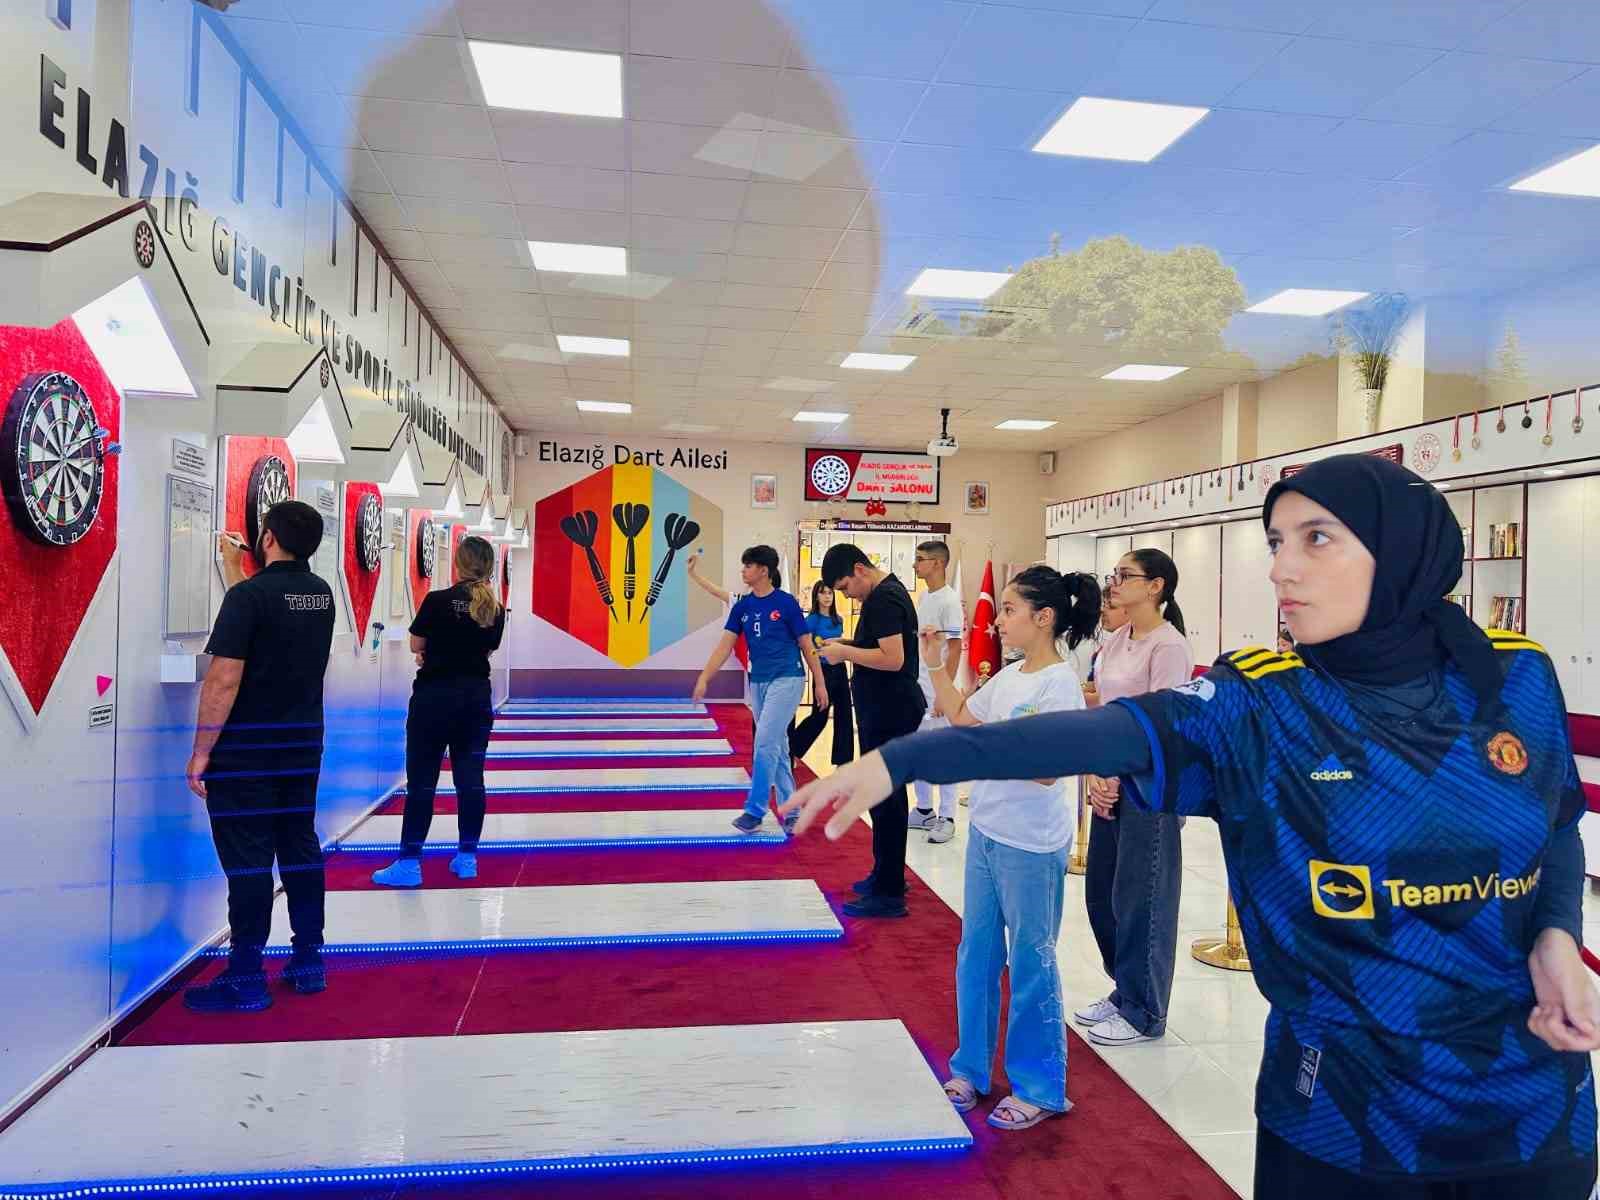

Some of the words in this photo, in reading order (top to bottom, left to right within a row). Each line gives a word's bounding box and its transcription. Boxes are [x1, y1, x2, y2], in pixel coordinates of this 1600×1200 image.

[39, 53, 200, 252] ELAZIĞ
[212, 216, 317, 345] GENÇLİK
[321, 308, 340, 365] VE
[345, 333, 381, 397] SPOR
[539, 442, 605, 470] Elazığ
[614, 445, 665, 466] Dart
[670, 448, 727, 470] Ailesi
[889, 482, 934, 495] SALONU
[753, 621, 761, 638] 9
[1310, 769, 1353, 781] adidas
